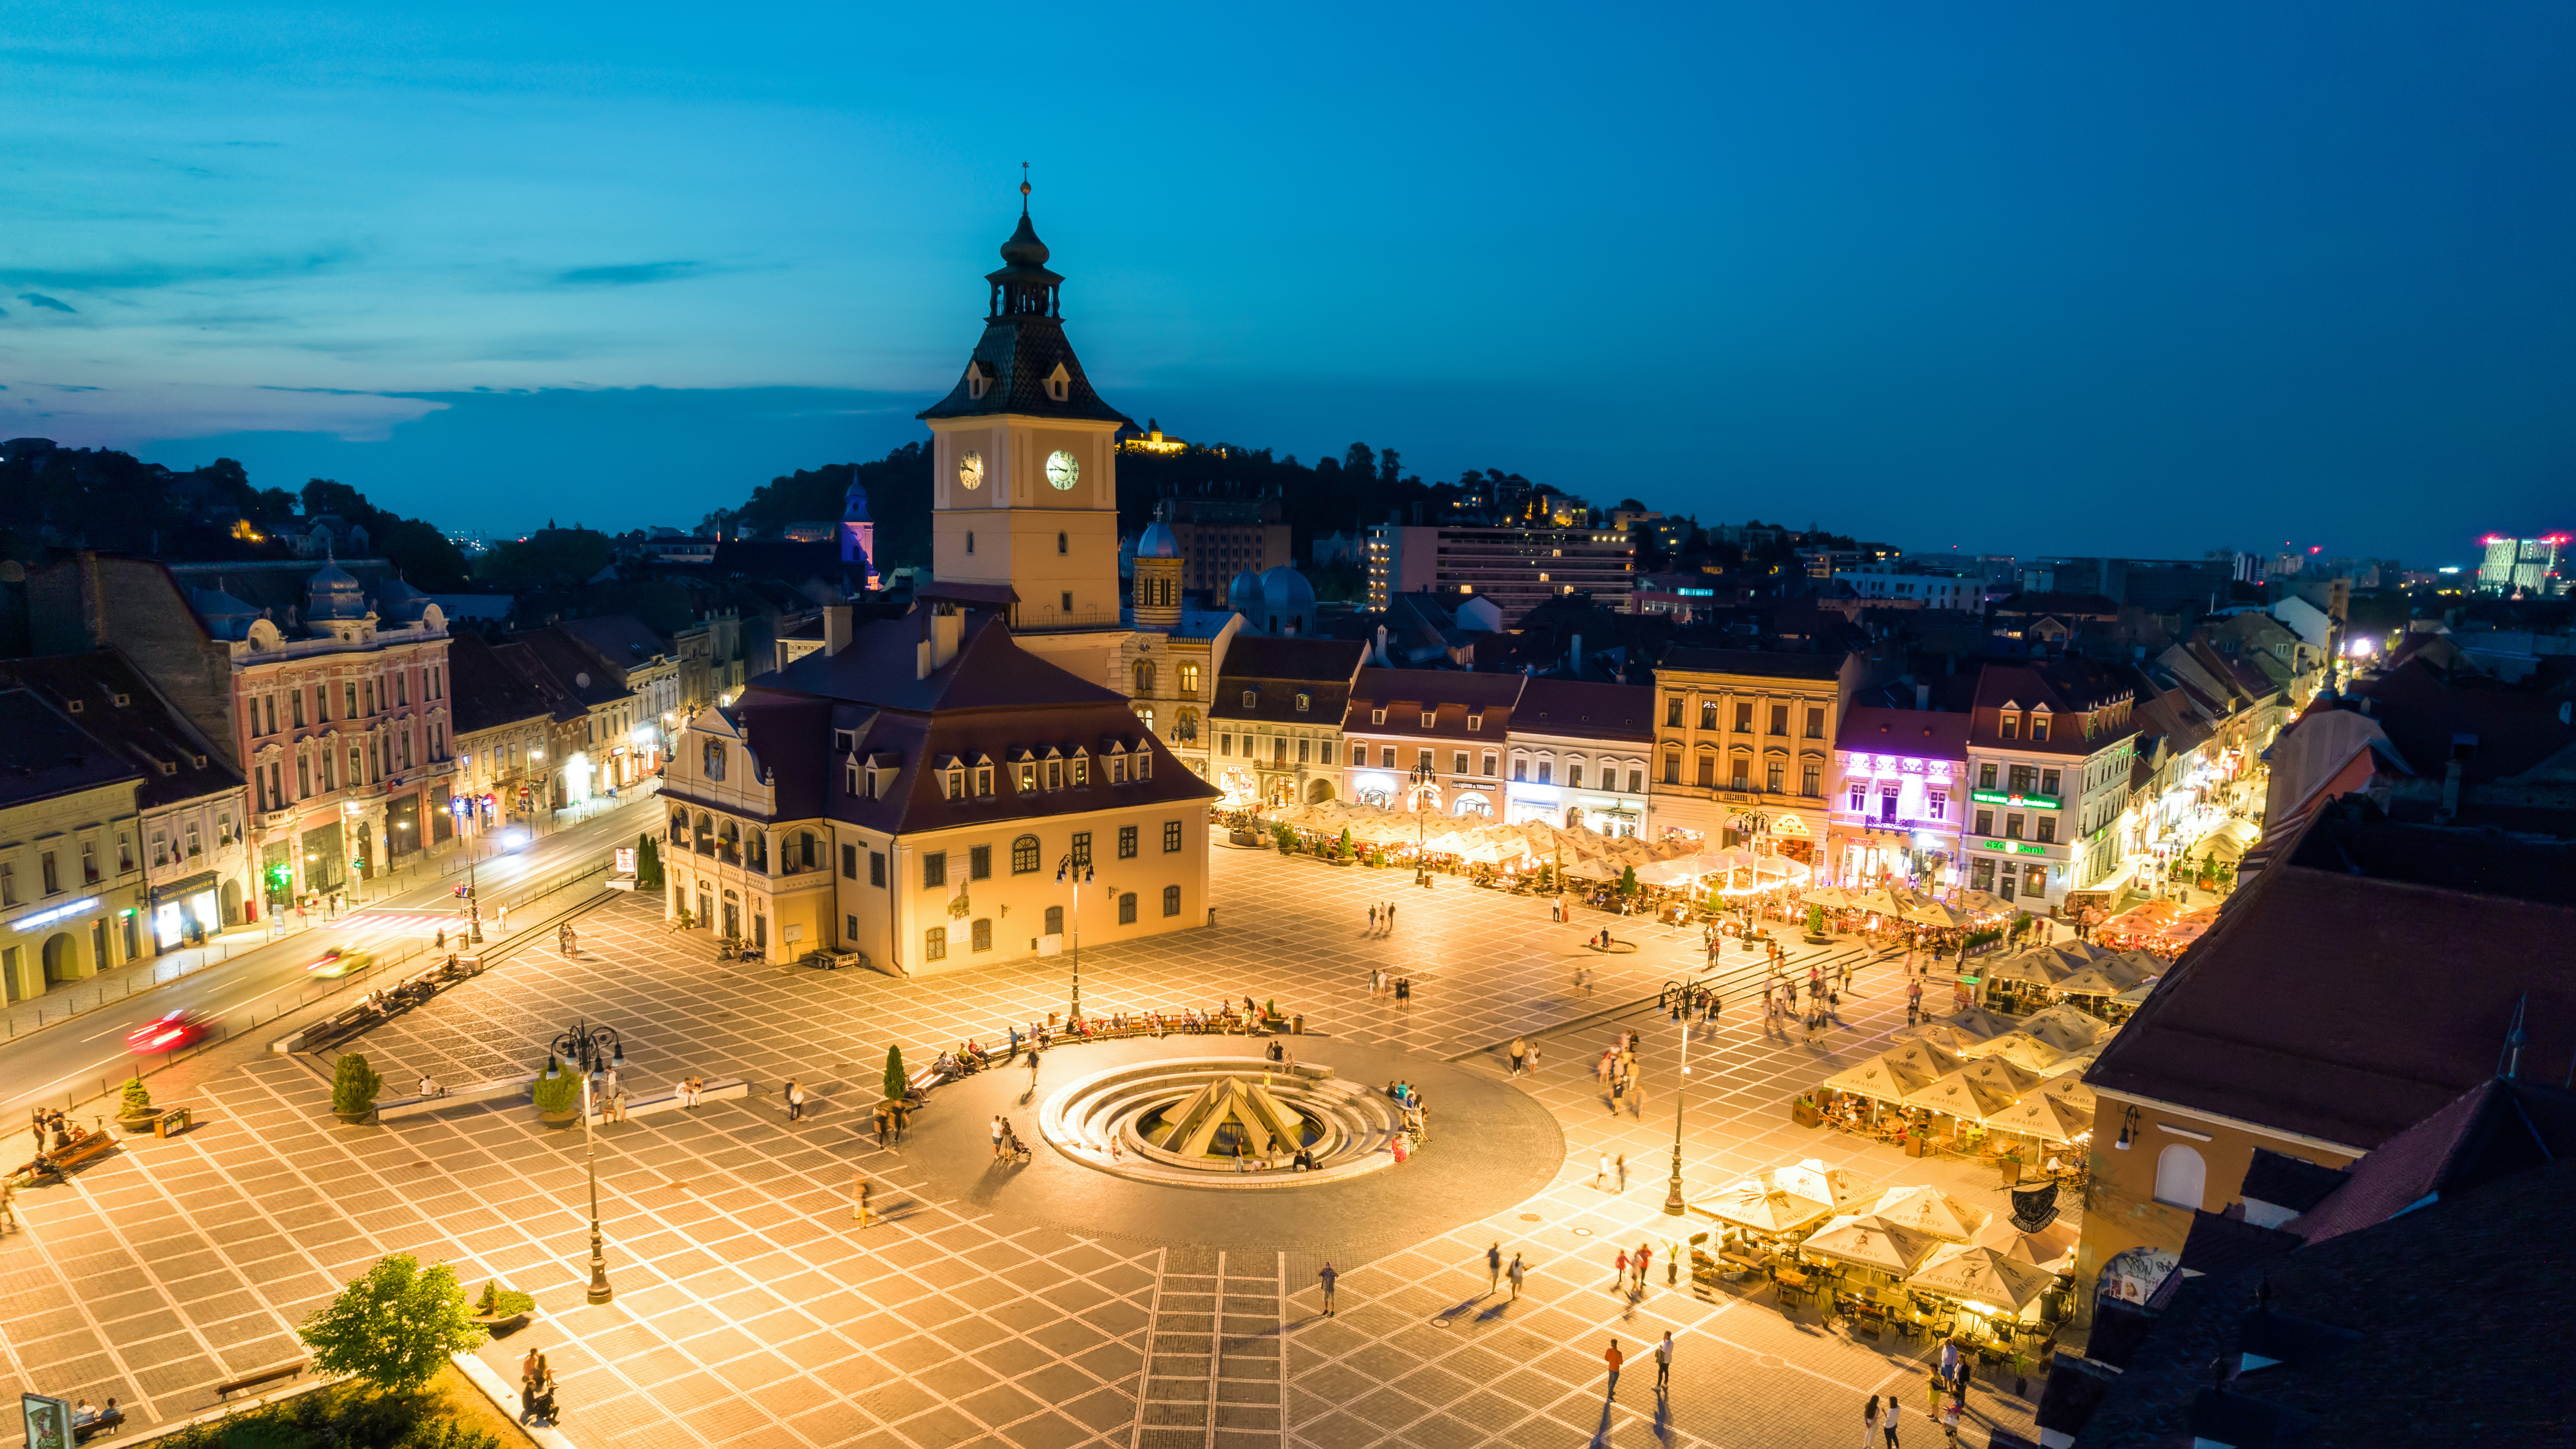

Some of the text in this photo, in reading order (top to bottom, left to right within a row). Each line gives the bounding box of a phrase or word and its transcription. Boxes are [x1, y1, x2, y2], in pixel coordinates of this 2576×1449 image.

[1227, 766, 1244, 774] KFC
[1984, 841, 2045, 854] CEC Bank
[1927, 1274, 2003, 1296] KRONSTADT
